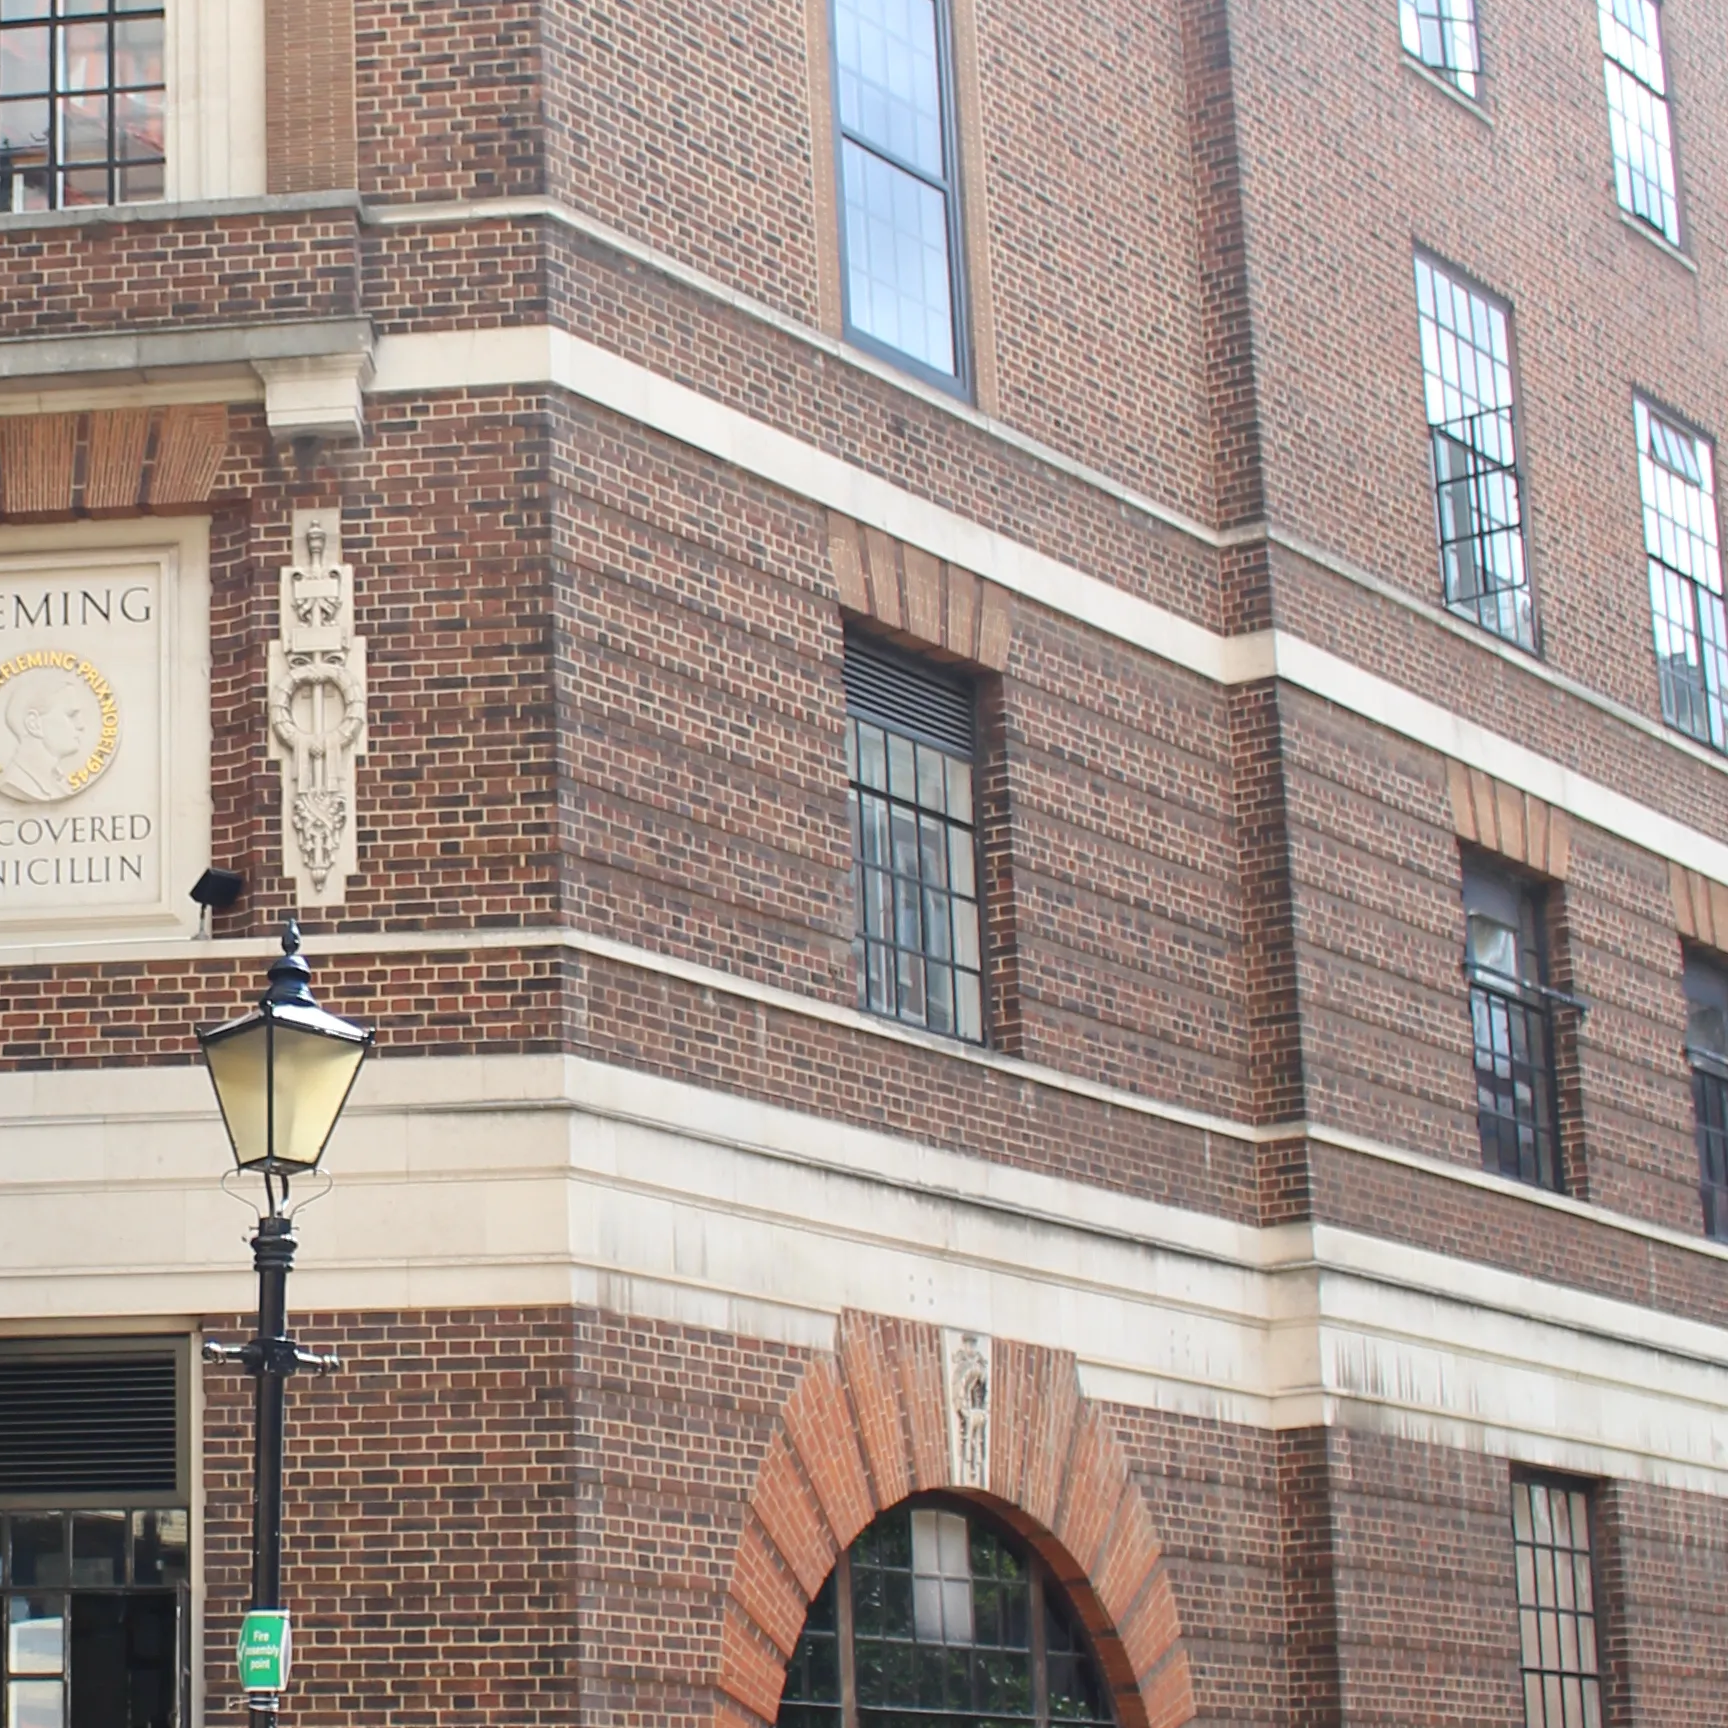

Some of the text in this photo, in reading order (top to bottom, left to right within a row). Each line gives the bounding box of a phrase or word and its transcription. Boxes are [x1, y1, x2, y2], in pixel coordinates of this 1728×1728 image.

[0, 650, 77, 680] FLEMING
[76, 661, 113, 700] PRIX
[97, 697, 119, 756] NOBEL
[68, 753, 105, 791] 1945
[253, 1629, 270, 1642] Fire
[250, 1658, 271, 1672] point
